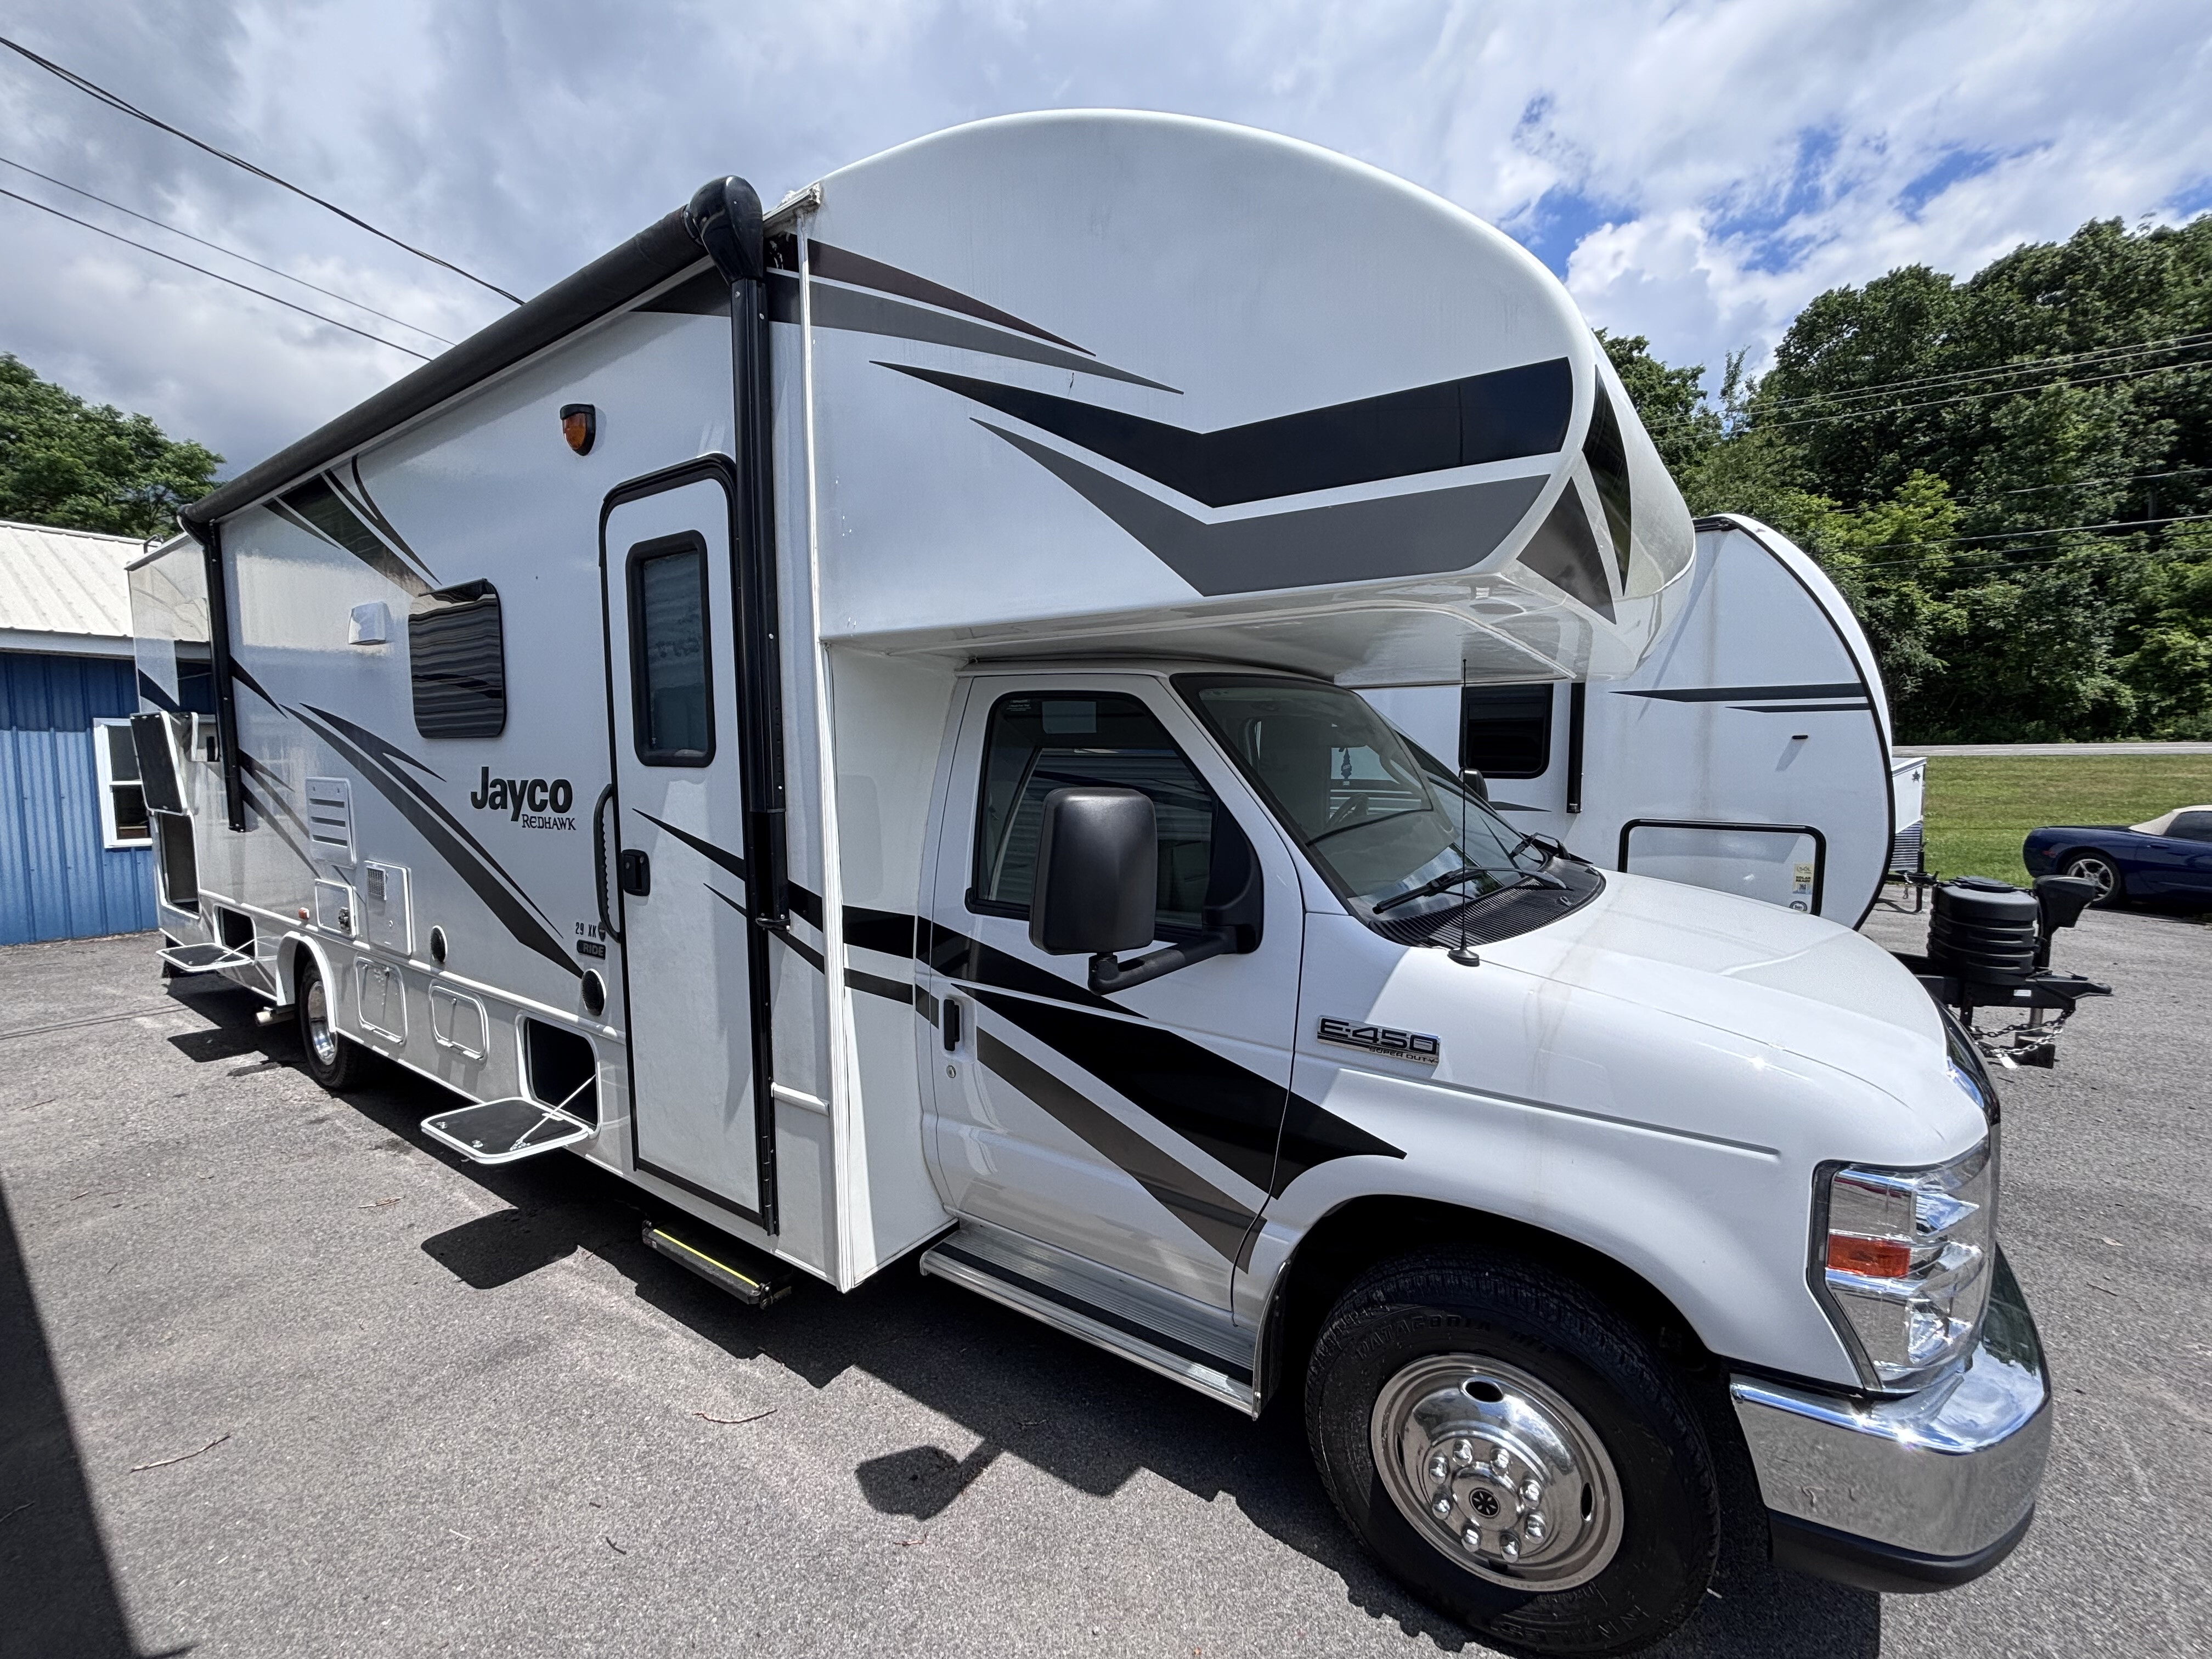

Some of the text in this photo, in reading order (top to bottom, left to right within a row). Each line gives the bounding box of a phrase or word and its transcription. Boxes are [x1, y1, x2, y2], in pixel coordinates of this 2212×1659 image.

[471, 766, 573, 822] Jayco
[522, 814, 576, 830] REDHAWK
[575, 922, 597, 938] 29 XK
[1320, 1018, 1438, 1054] E-450
[1369, 1046, 1438, 1063] SUPER DUTY
